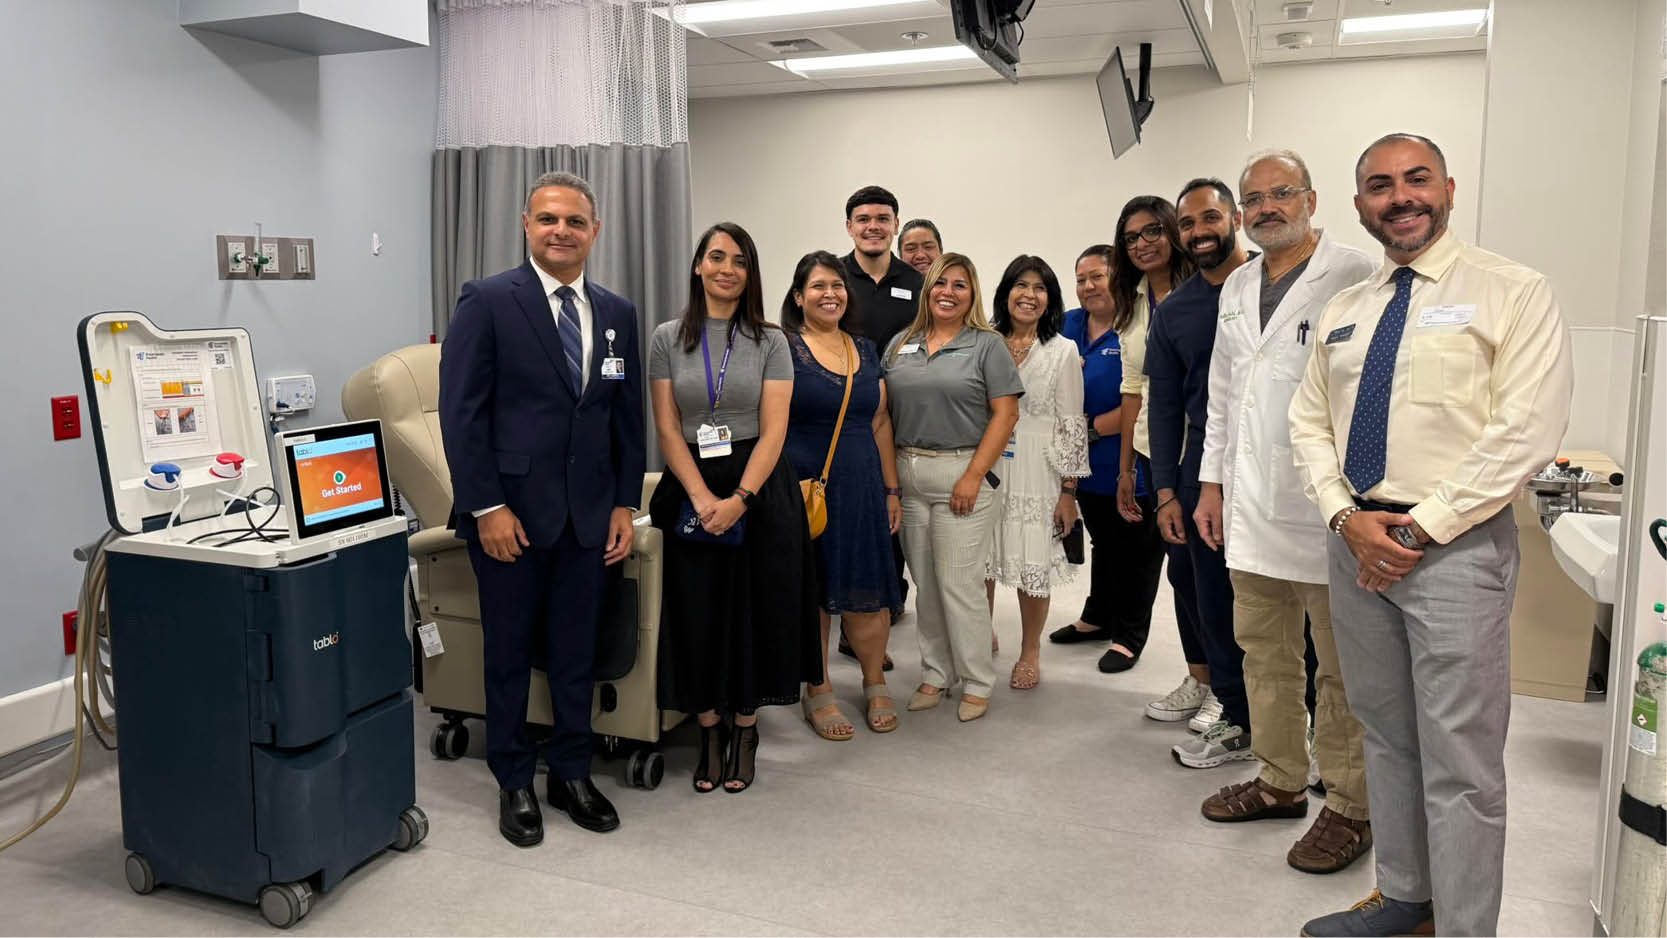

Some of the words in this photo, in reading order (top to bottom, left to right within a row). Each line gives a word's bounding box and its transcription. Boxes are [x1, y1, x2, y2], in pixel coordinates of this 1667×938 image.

[322, 488, 335, 498] Get
[335, 482, 362, 495] Started
[313, 633, 338, 651] tablo
